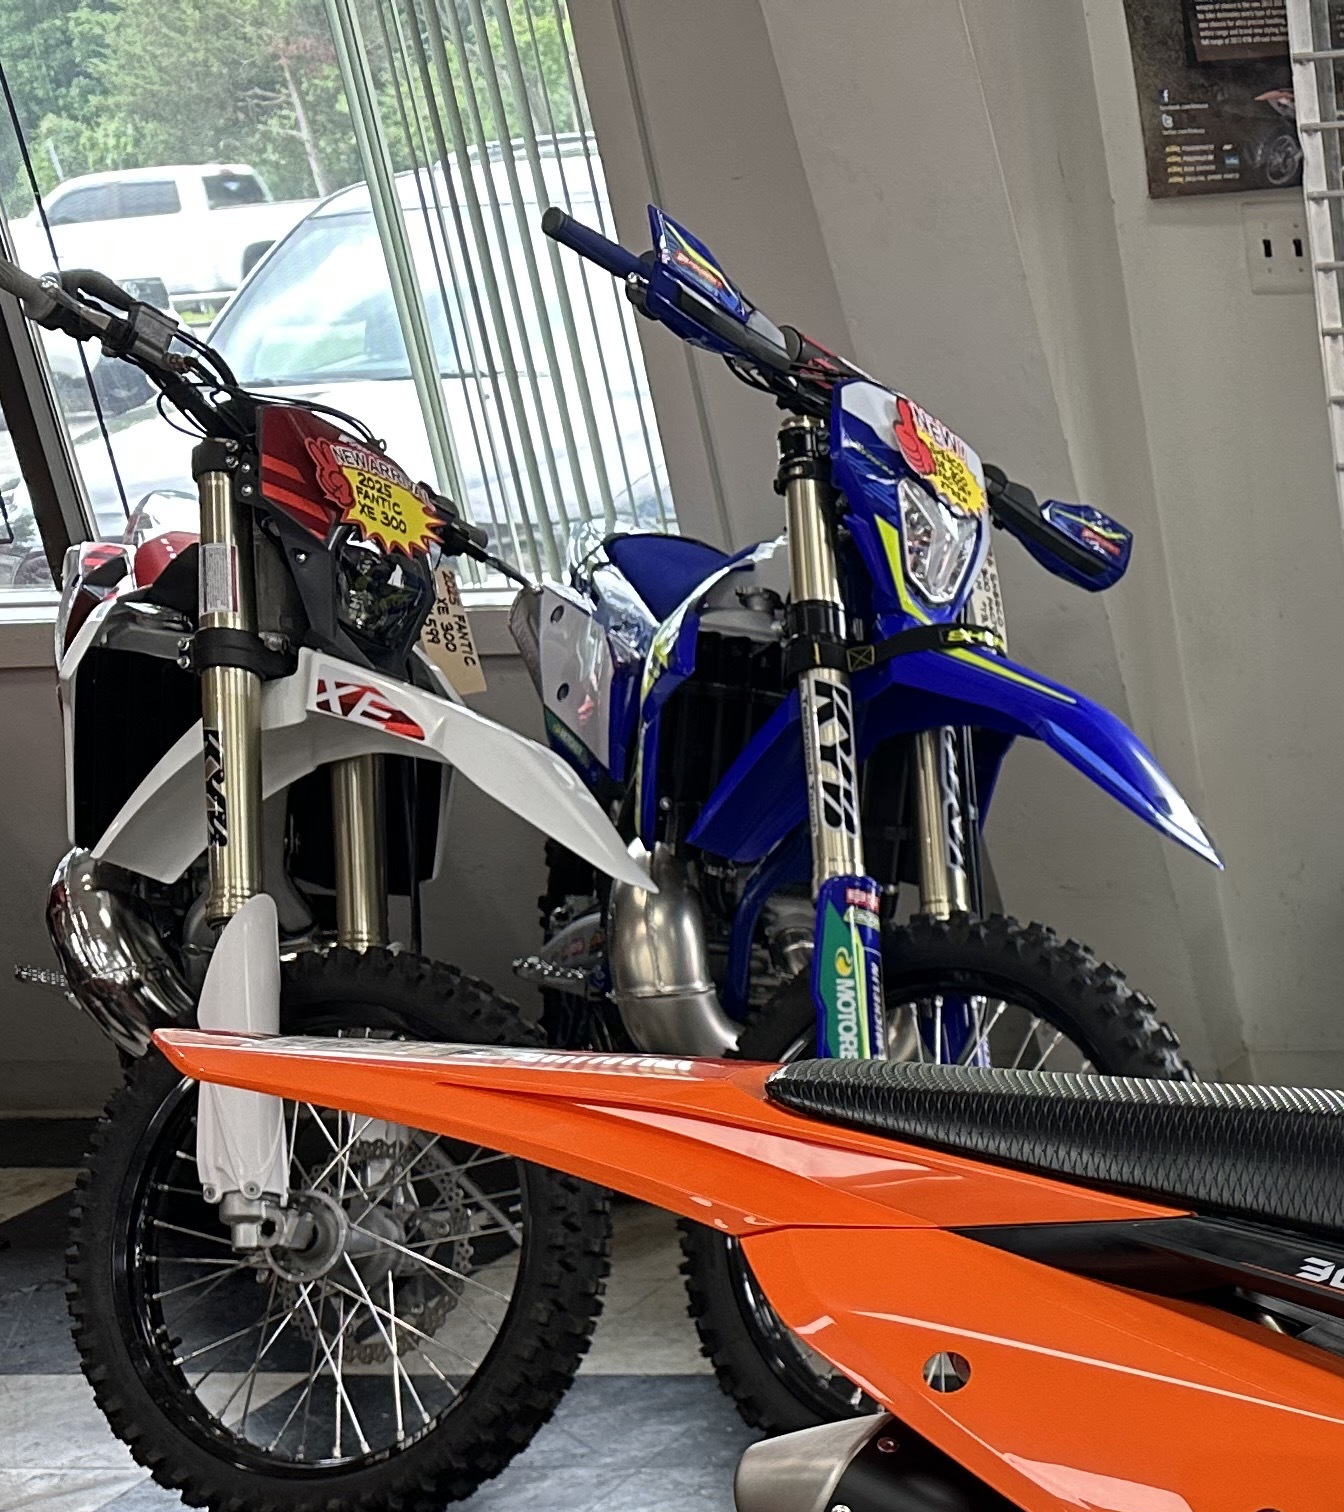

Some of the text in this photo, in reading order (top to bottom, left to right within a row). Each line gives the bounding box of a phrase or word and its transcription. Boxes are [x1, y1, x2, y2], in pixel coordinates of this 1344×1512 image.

[331, 445, 368, 472] NEW
[355, 484, 403, 518] FANTIC
[356, 471, 393, 499] 2025
[357, 500, 408, 535] XE 300
[437, 596, 458, 654] XE 300
[441, 570, 478, 668] 2025 FANTIC
[316, 676, 395, 728] XE
